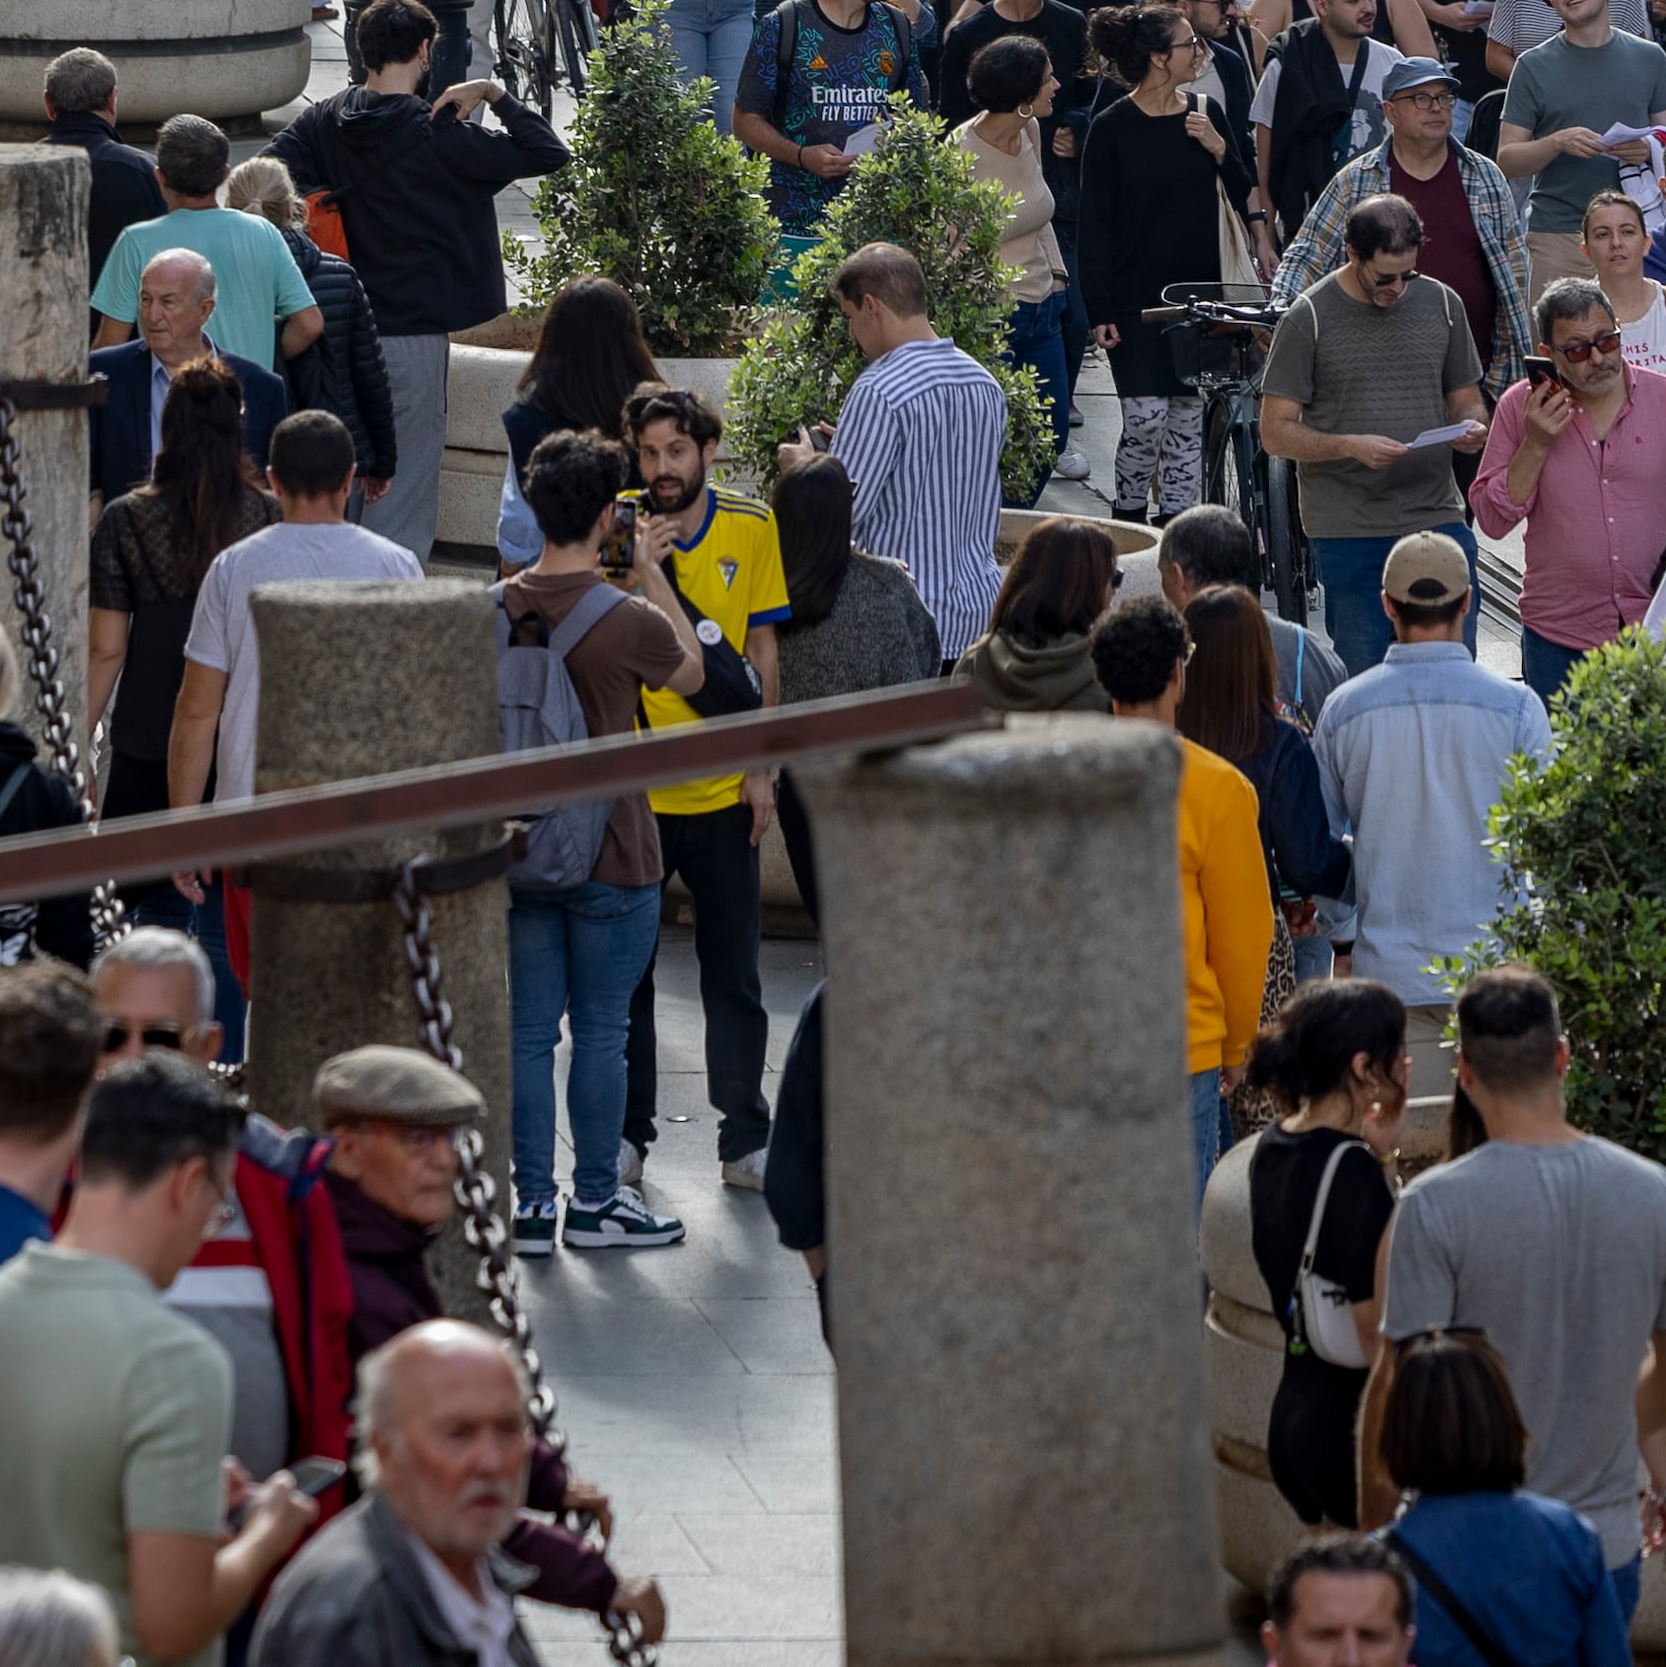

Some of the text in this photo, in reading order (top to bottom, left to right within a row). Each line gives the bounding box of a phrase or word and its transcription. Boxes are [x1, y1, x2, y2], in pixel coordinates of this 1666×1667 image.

[811, 83, 889, 104] Emirates
[821, 105, 879, 122] FLY BETTER
[1621, 342, 1649, 354] HIS
[1628, 354, 1666, 367] RITA
